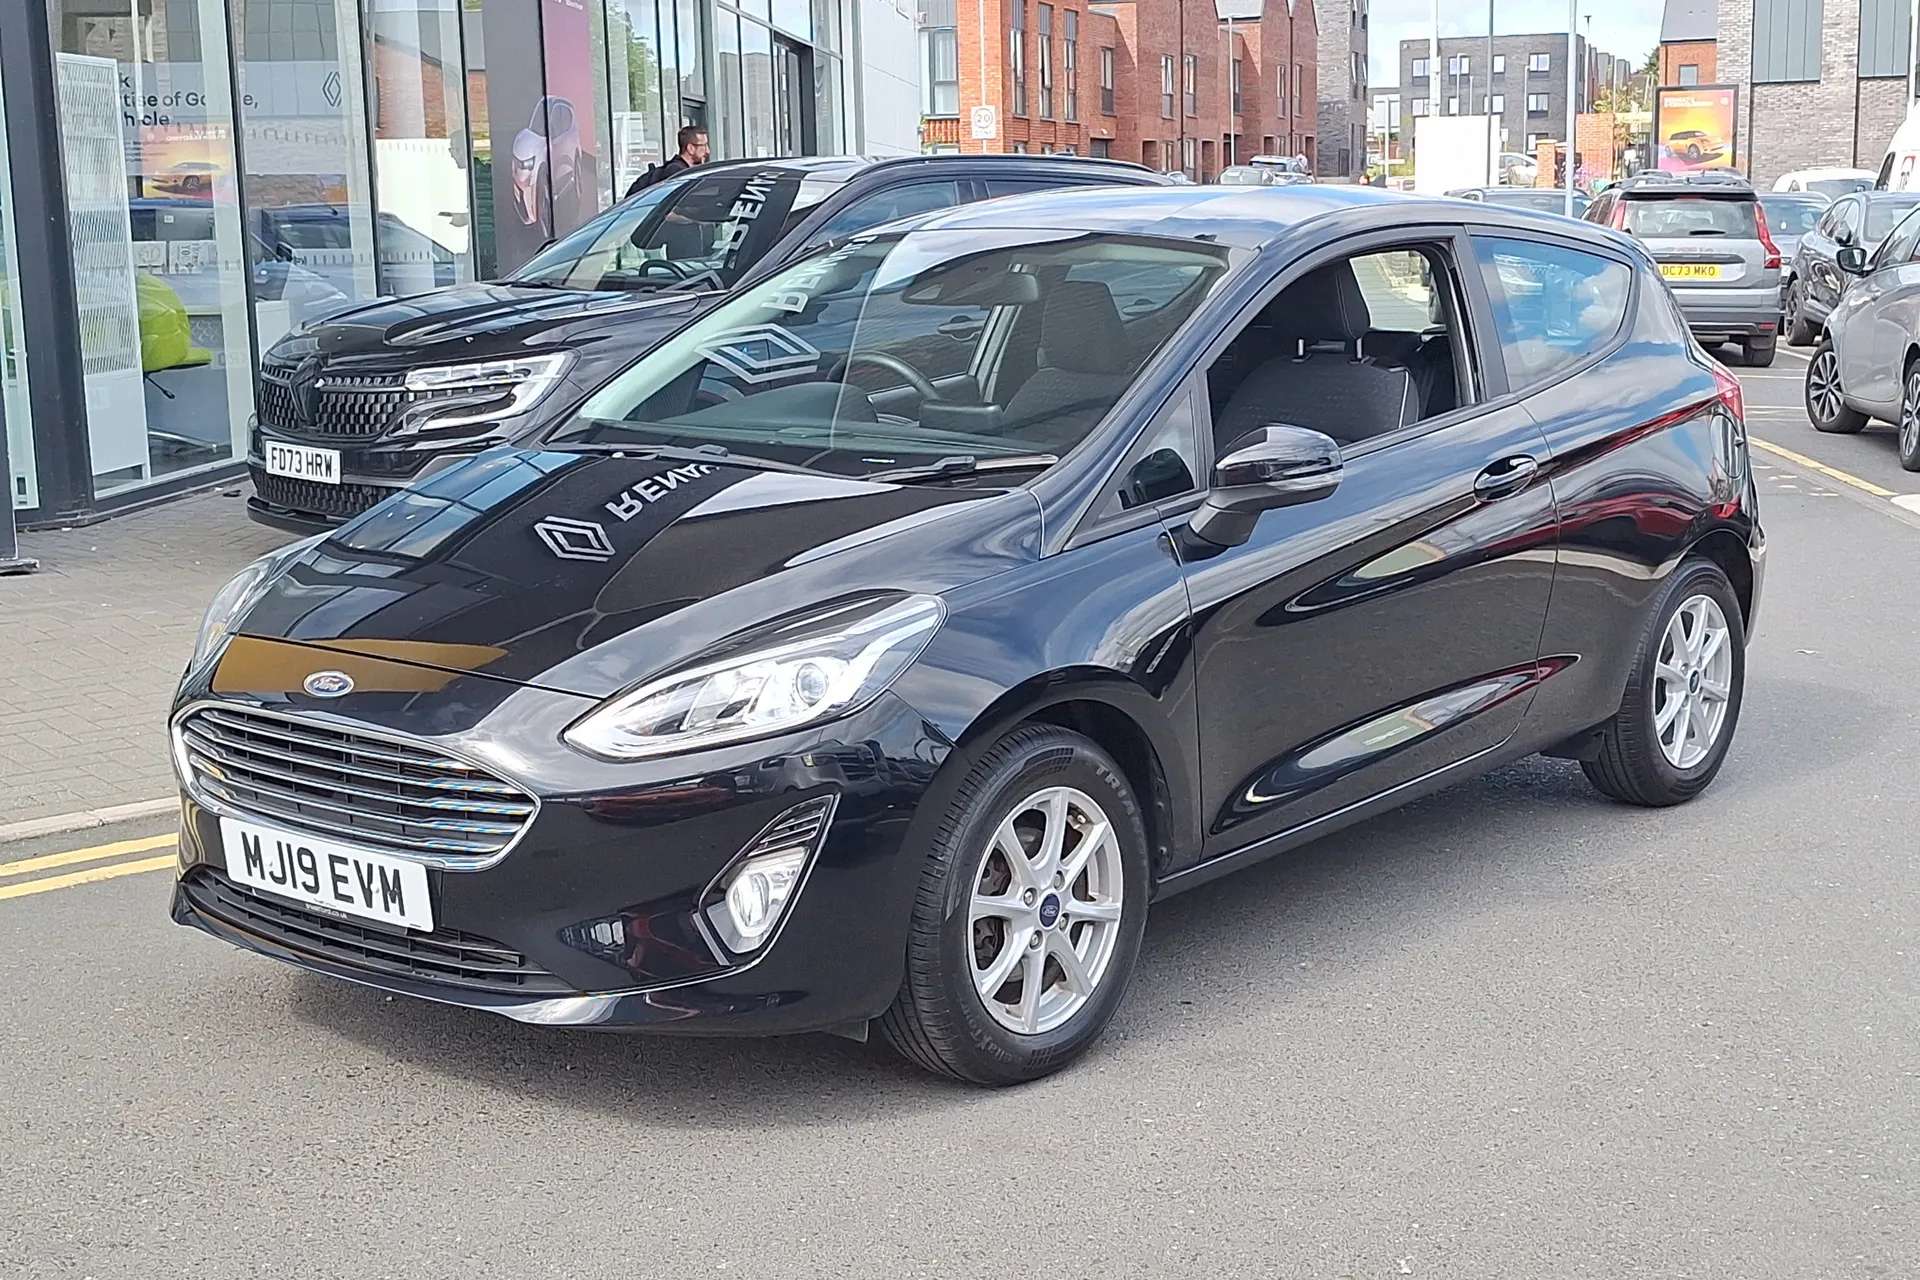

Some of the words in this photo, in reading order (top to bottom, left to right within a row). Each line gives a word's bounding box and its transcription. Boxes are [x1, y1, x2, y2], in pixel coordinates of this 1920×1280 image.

[163, 91, 181, 107] of
[976, 113, 990, 122] 20
[271, 446, 303, 474] FD73
[306, 451, 333, 478] HRW
[241, 831, 320, 895] MJ19
[328, 853, 406, 917] EVM
